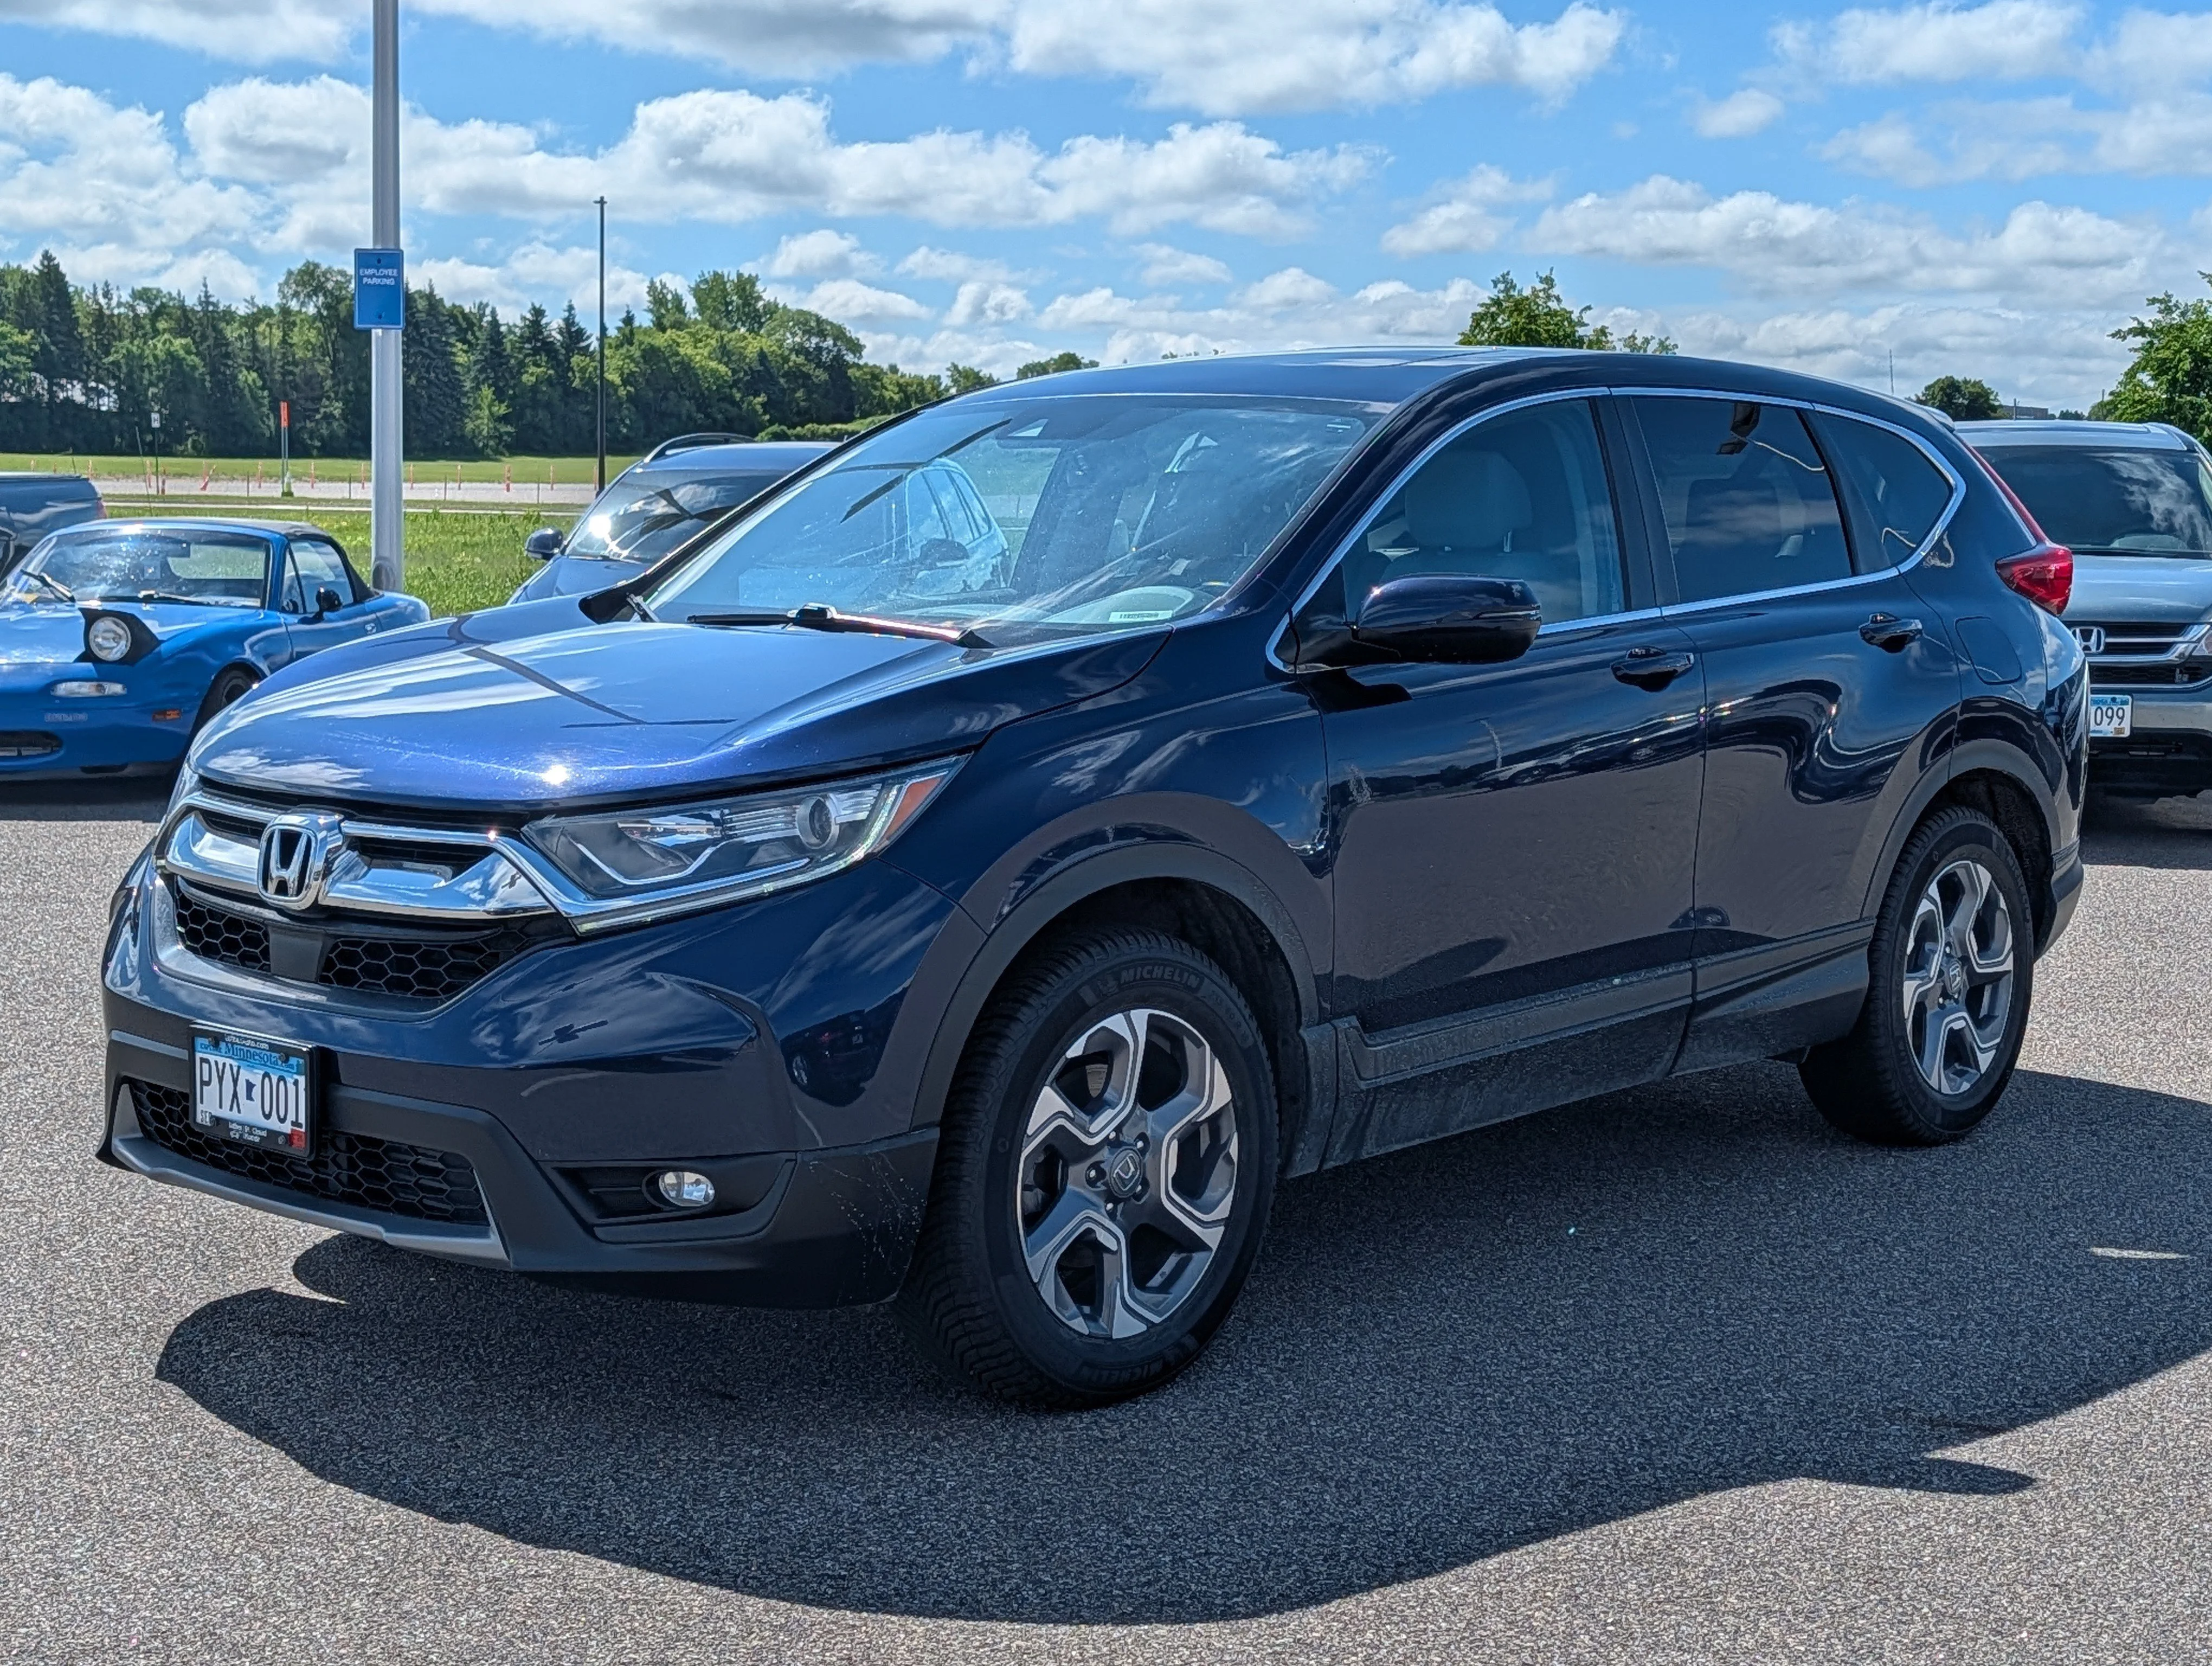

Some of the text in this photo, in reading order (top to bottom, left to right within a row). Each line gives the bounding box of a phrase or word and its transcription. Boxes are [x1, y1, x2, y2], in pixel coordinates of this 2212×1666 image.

[359, 268, 398, 277] EMPLOYEE
[363, 277, 395, 285] PARKING
[2094, 706, 2125, 726] 099
[1120, 965, 1201, 988] MICHELIN
[224, 1042, 279, 1066] Minnesota
[199, 1057, 303, 1129] PYX 001
